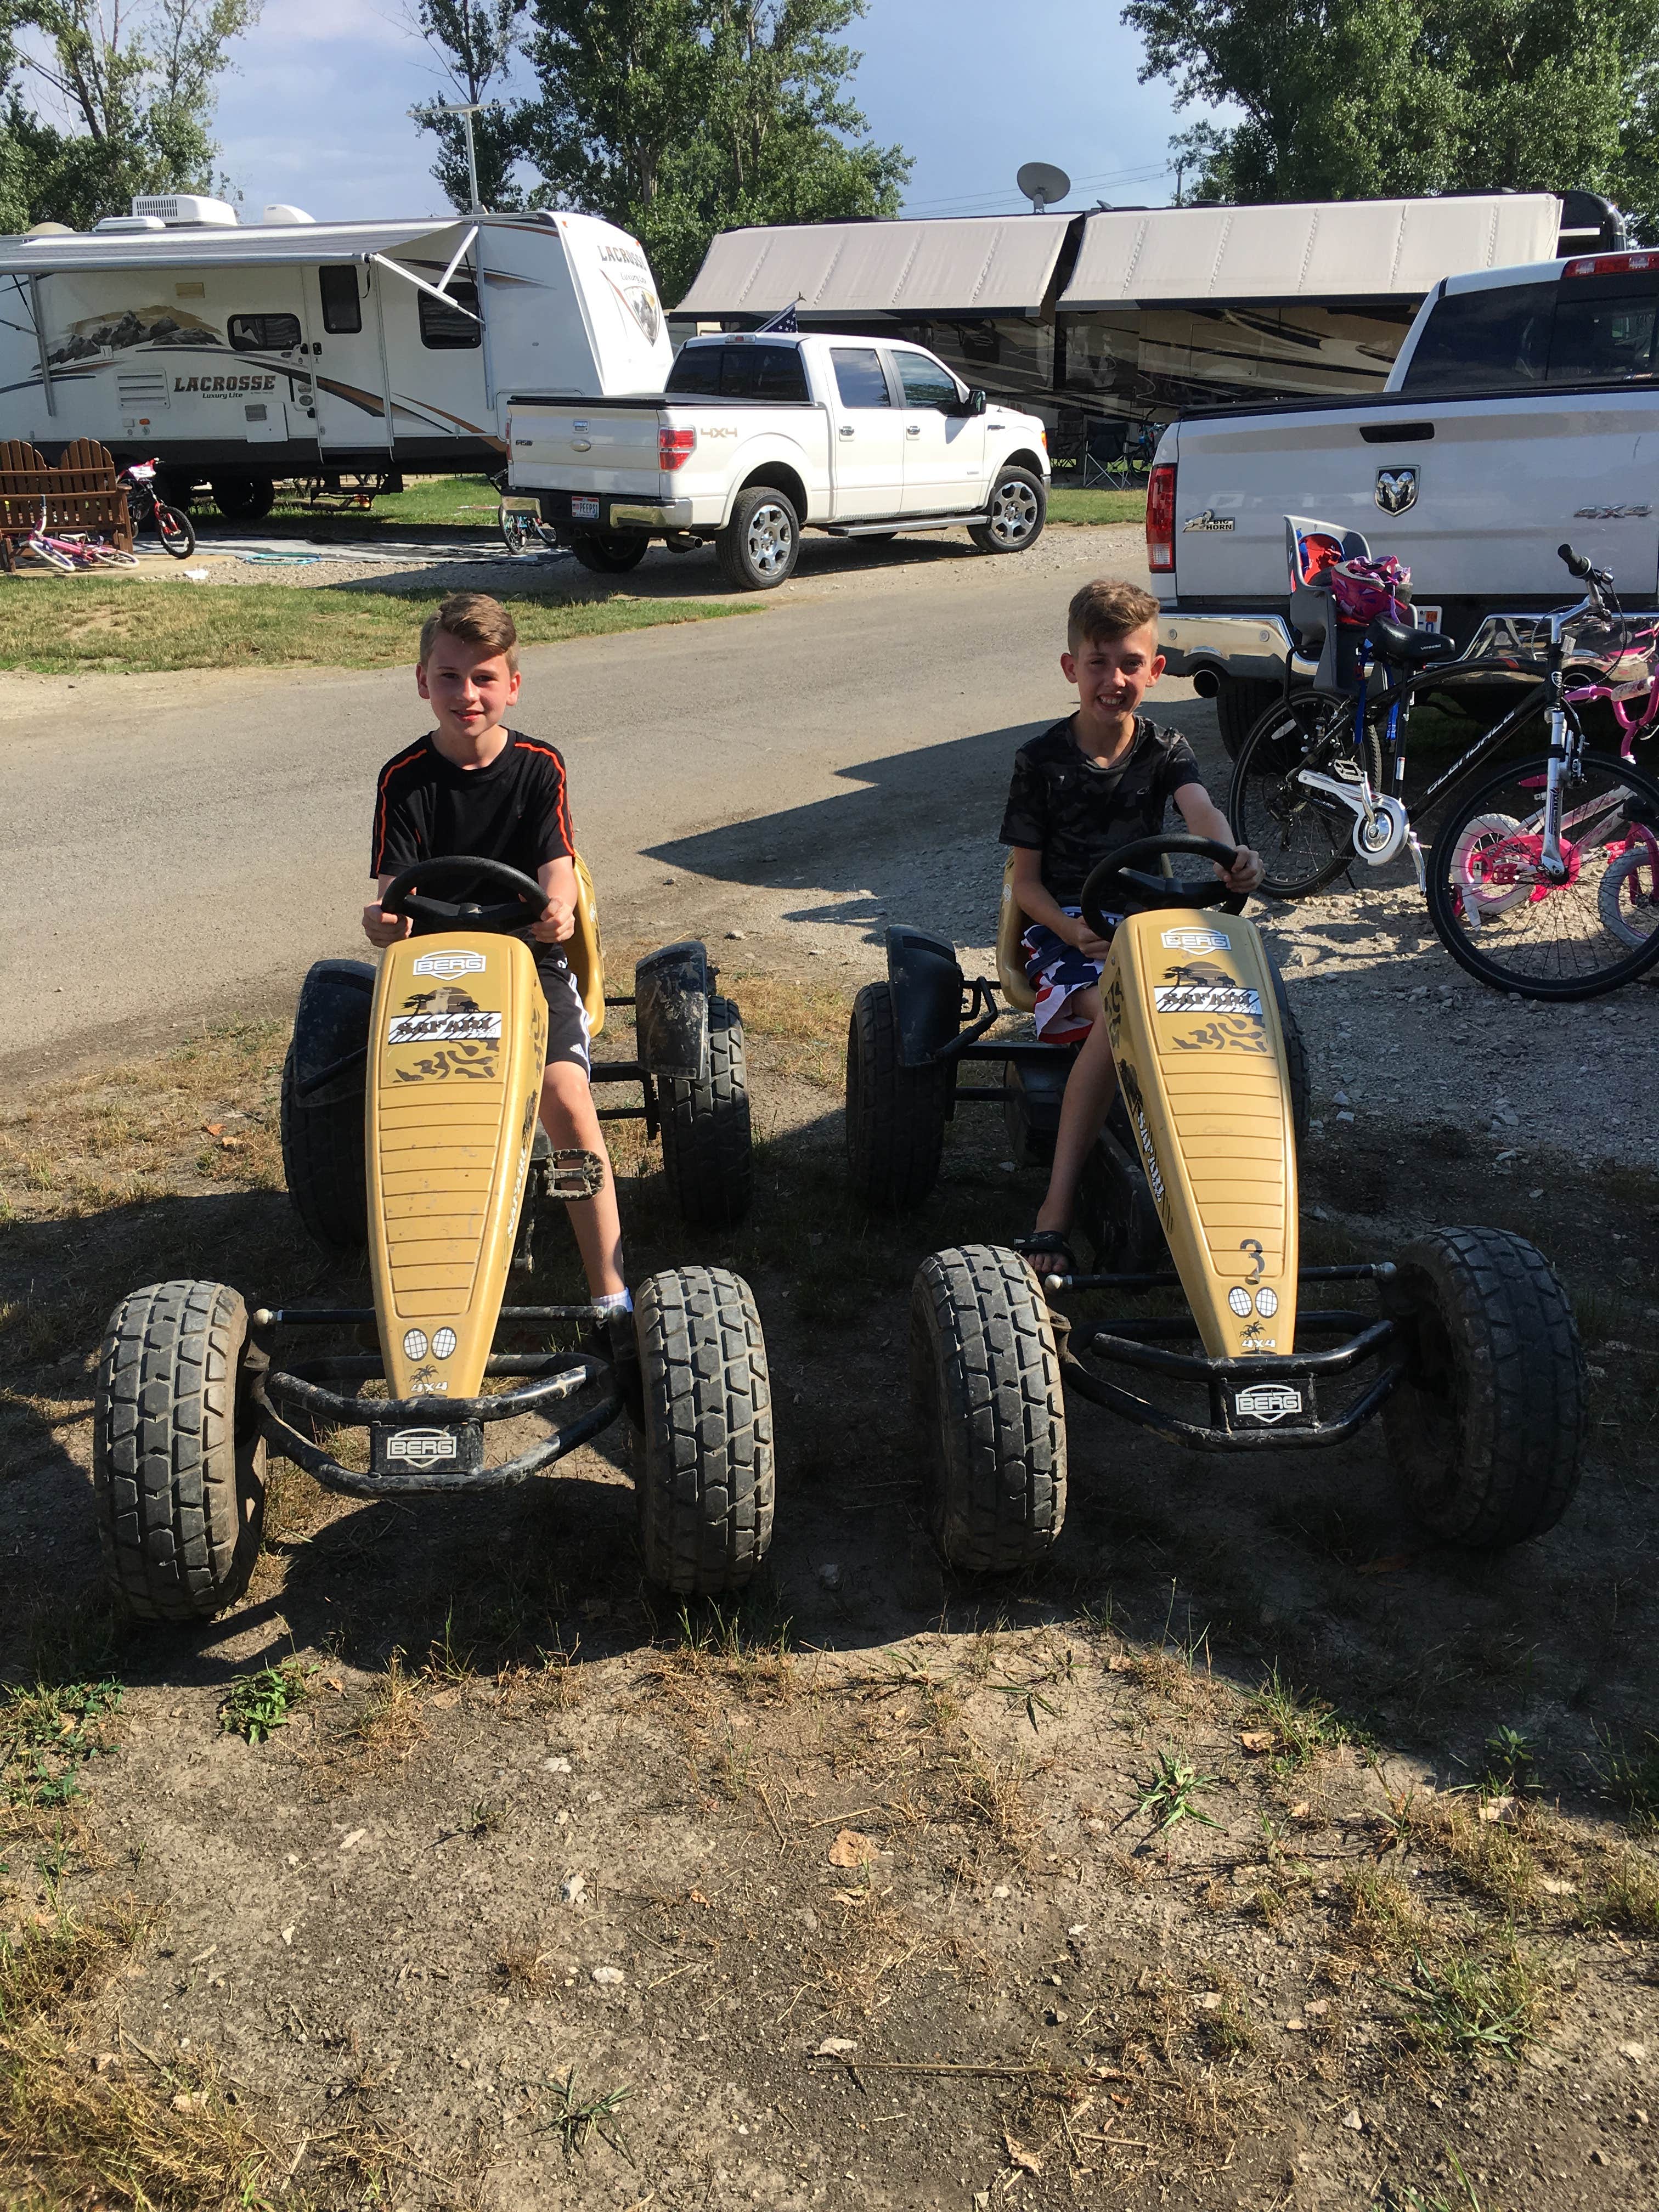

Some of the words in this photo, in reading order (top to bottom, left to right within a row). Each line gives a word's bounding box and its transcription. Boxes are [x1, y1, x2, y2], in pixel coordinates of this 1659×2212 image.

[597, 245, 647, 271] LACROSSE
[174, 375, 275, 392] LACROSSE
[1164, 935, 1227, 947] BERG
[417, 958, 482, 972] BERG
[1162, 991, 1253, 1007] SAFARI
[397, 1017, 493, 1035] SAFARI
[1240, 1239, 1265, 1285] 3
[1239, 1395, 1298, 1411] BERG
[391, 1440, 453, 1455] BERG
